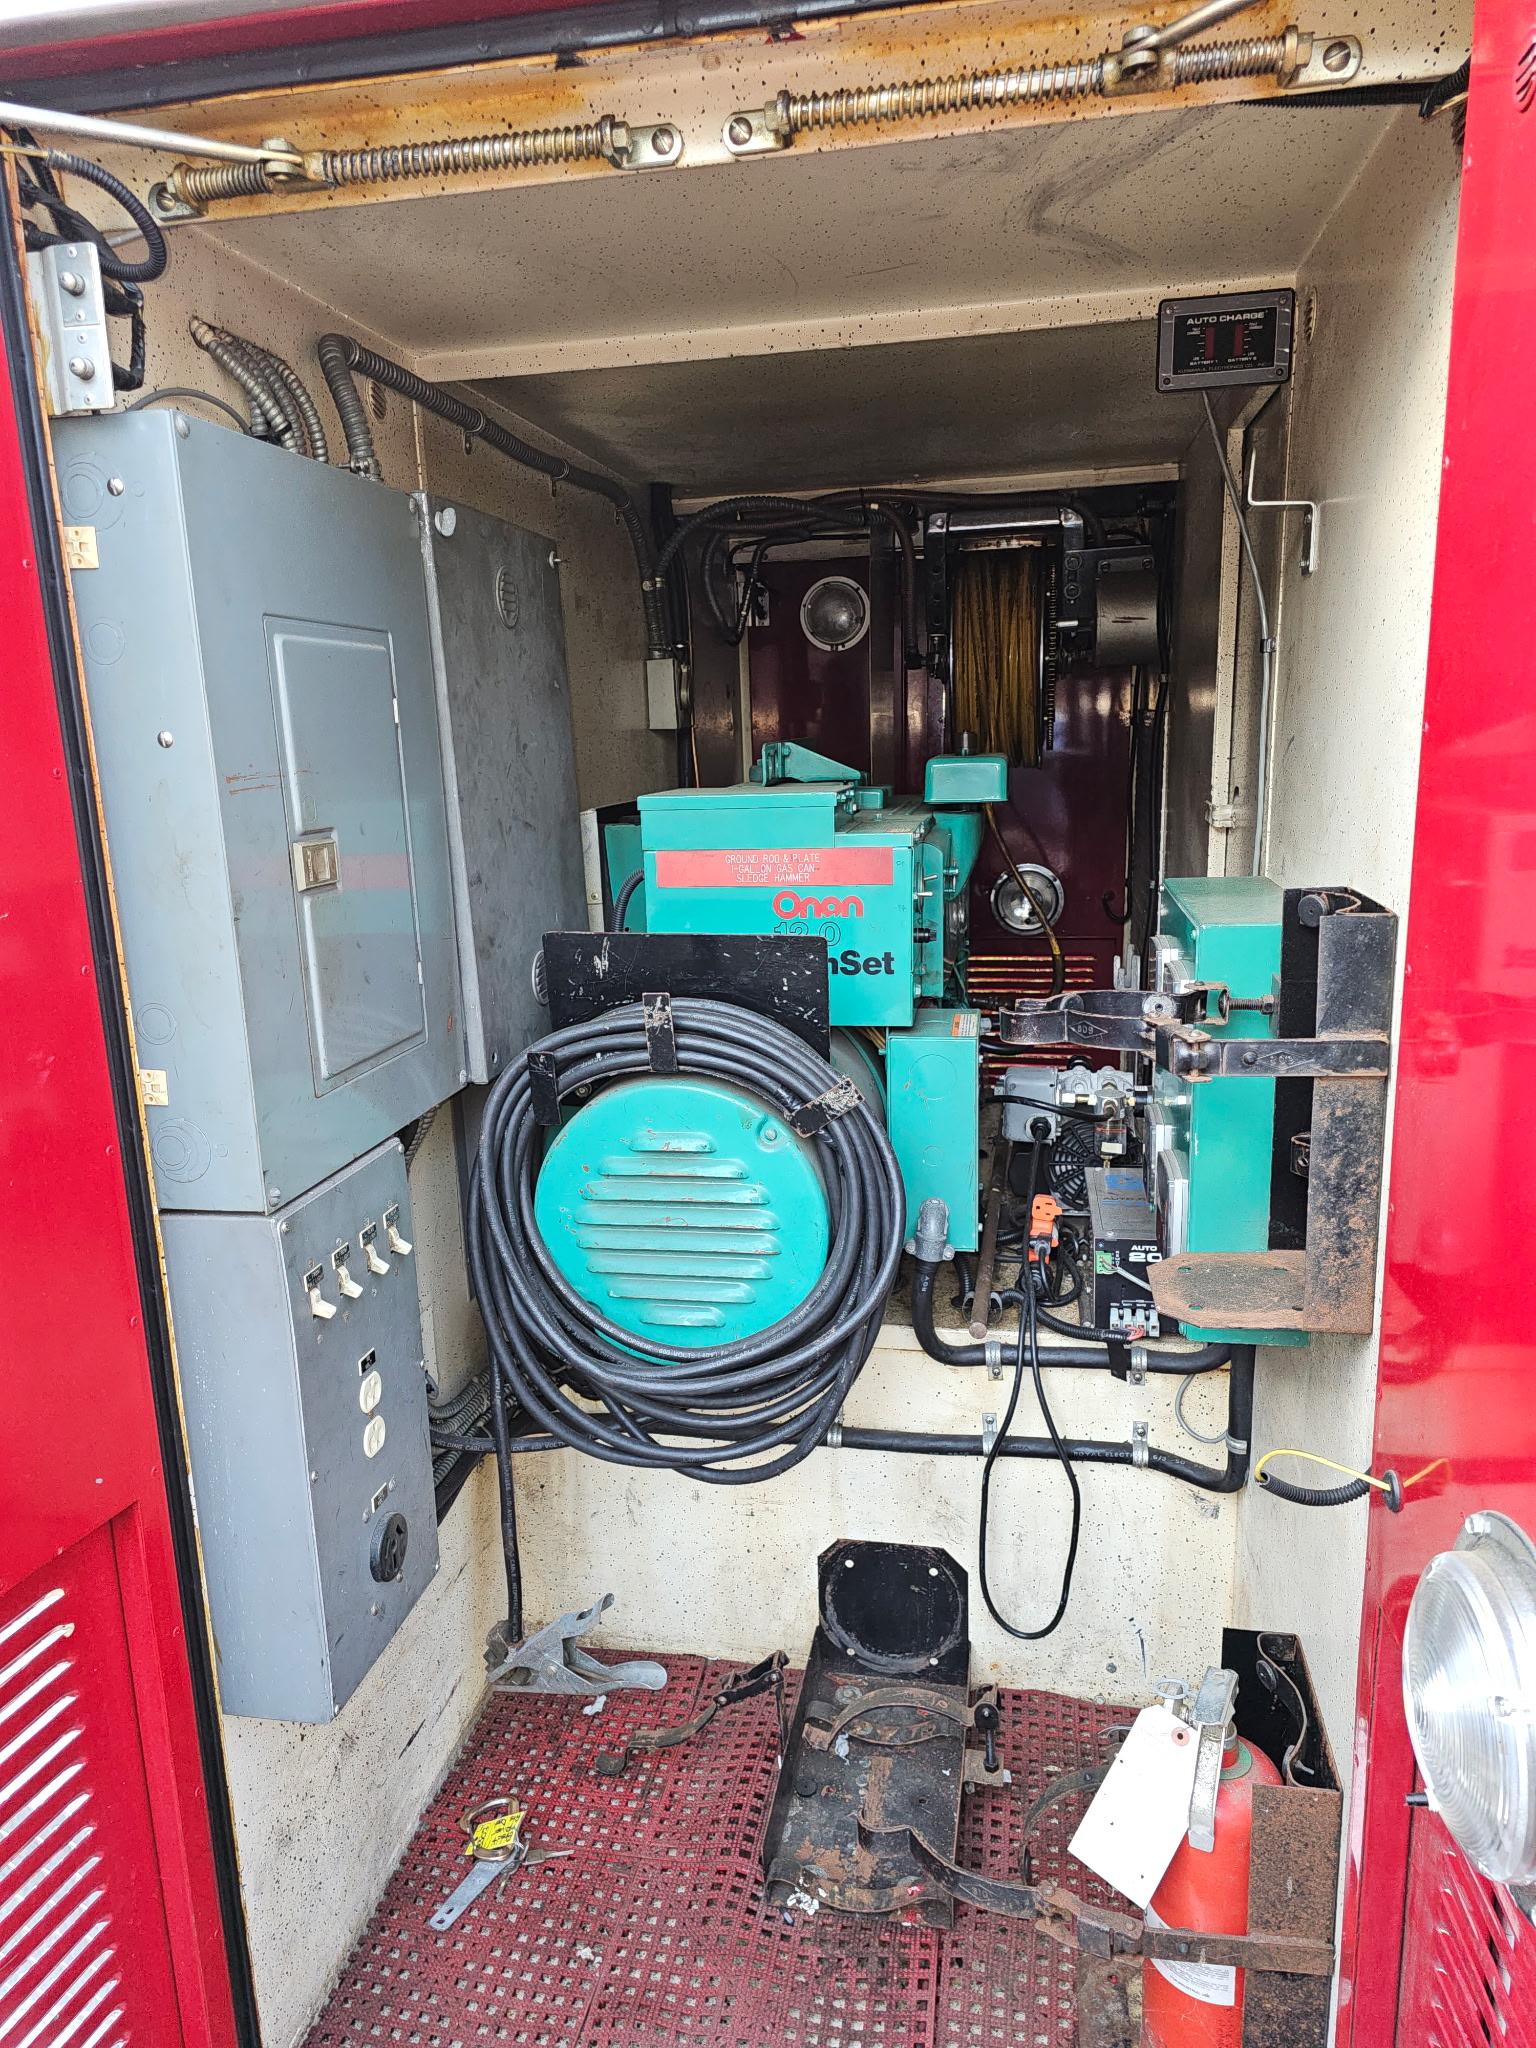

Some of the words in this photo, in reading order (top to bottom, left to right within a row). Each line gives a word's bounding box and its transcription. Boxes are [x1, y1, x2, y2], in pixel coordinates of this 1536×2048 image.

[1186, 316, 1218, 325] AUTO
[1220, 312, 1264, 322] CHARGE
[725, 854, 758, 864] GROUND
[764, 854, 780, 863] ROD
[783, 854, 789, 862] &
[792, 854, 820, 862] PLATE
[776, 864, 793, 873] GAS
[797, 864, 815, 873] CAN
[736, 874, 769, 883] SLEDGE
[774, 873, 810, 882] HAMMER
[772, 890, 864, 920] Onan
[1129, 1252, 1163, 1262] 20
[570, 1296, 595, 1320] WELDING
[595, 1317, 615, 1333] CABLE
